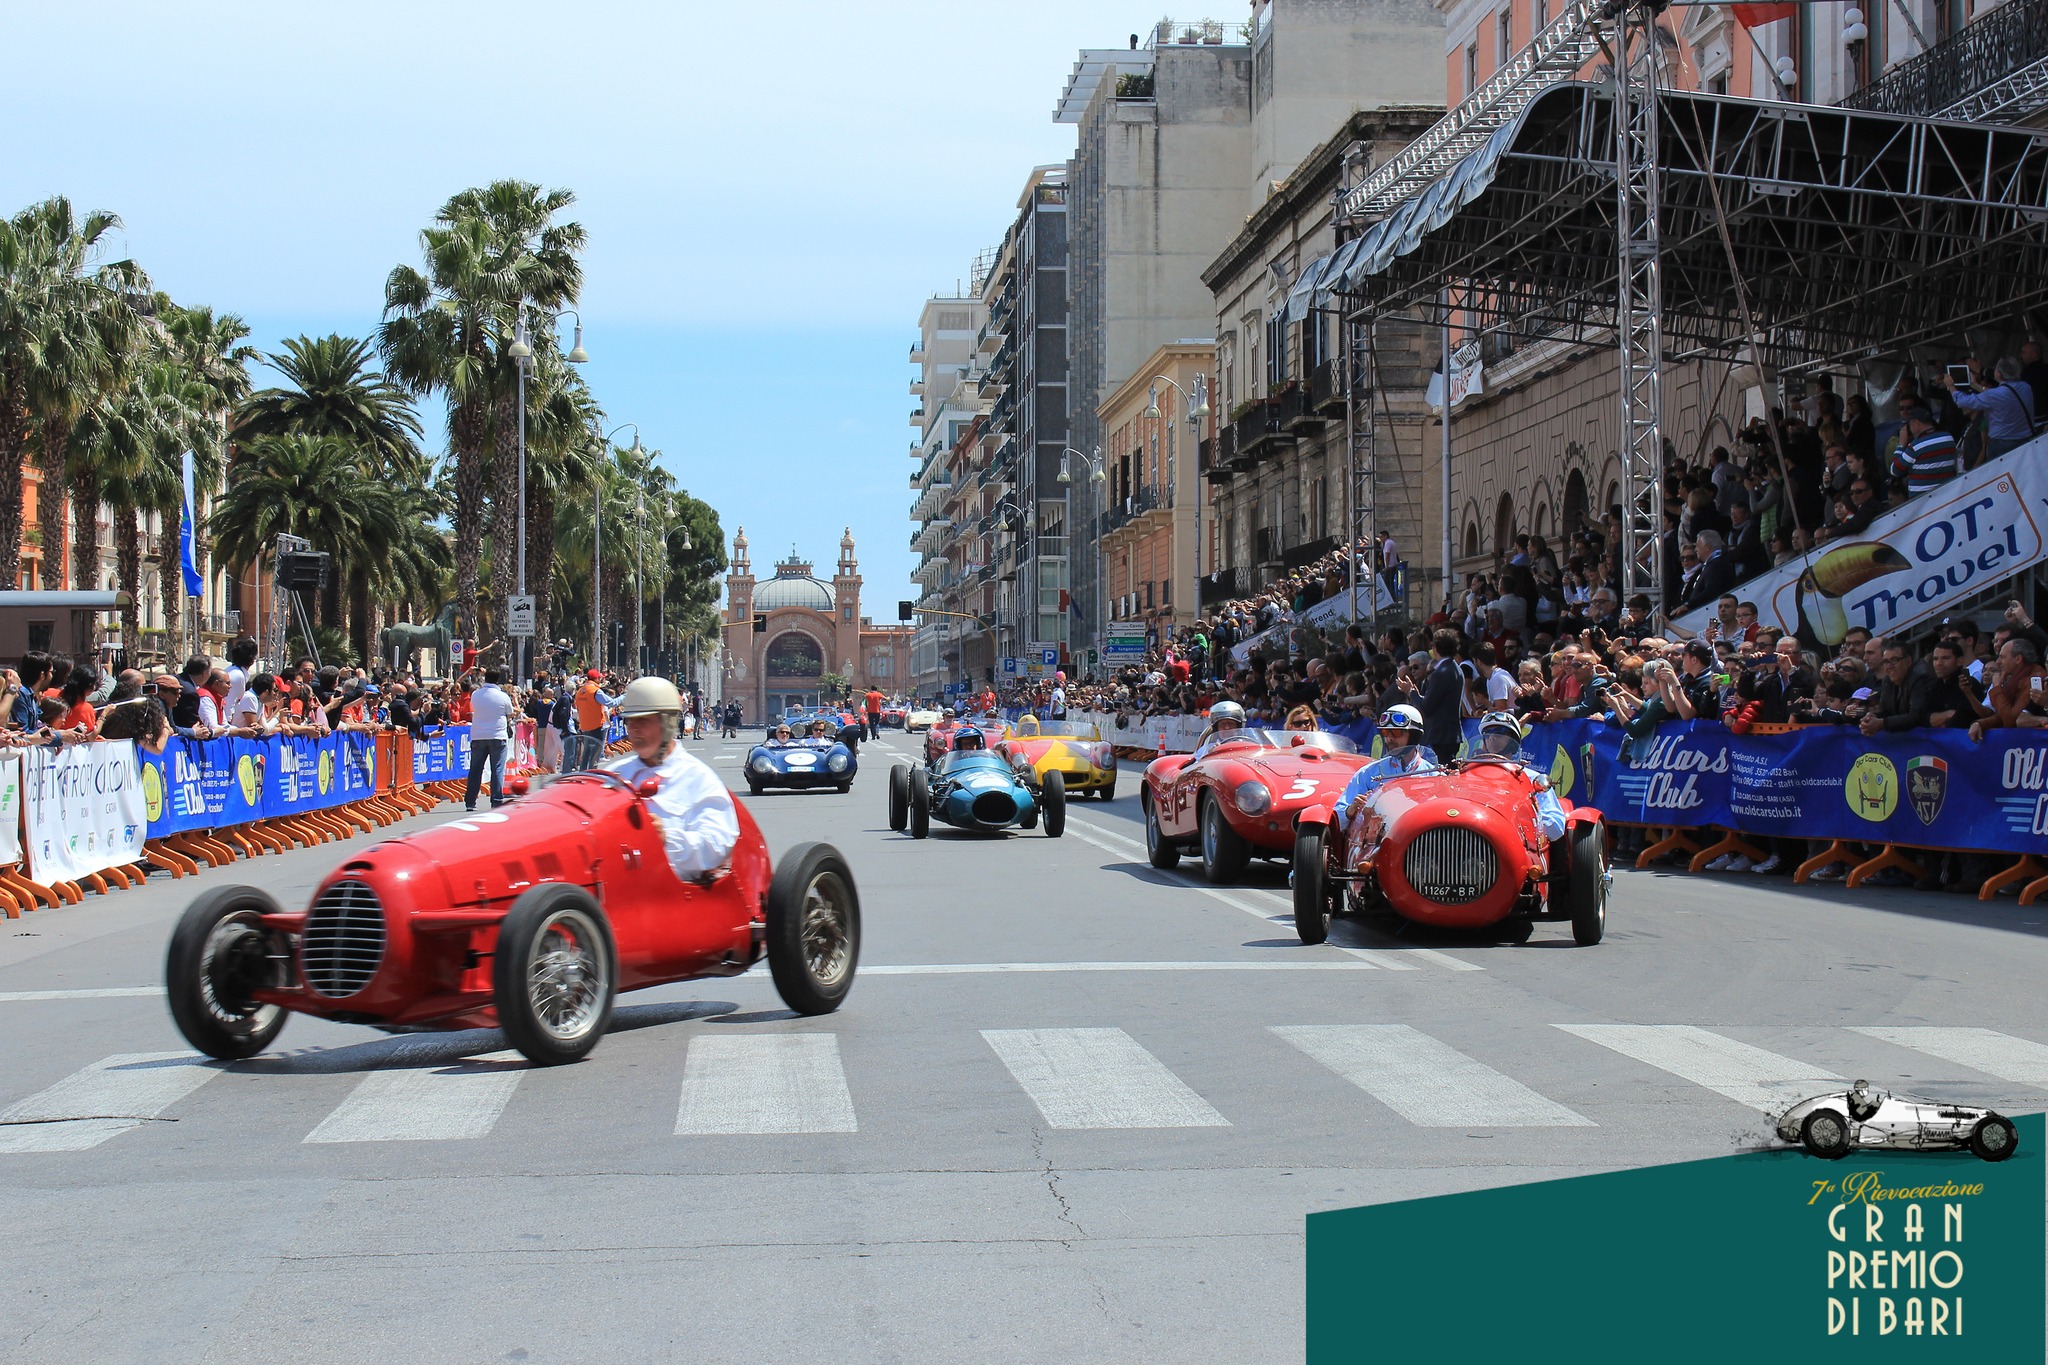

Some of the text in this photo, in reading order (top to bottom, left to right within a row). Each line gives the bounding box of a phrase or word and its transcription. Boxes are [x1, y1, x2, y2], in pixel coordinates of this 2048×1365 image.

[1915, 497, 1994, 562] O.T.
[1851, 524, 2021, 630] Travel
[1044, 651, 1055, 663] P
[1006, 660, 1014, 671] P
[945, 685, 952, 694] P
[958, 683, 965, 692] P
[1663, 735, 1729, 773] Cars
[1731, 751, 1755, 763] Federato
[1783, 768, 1798, 777] Bari
[2002, 747, 2047, 790] Old
[1801, 777, 1843, 786] oldcarsclub.it
[1281, 778, 1320, 800] 3
[1646, 772, 1703, 809] Club
